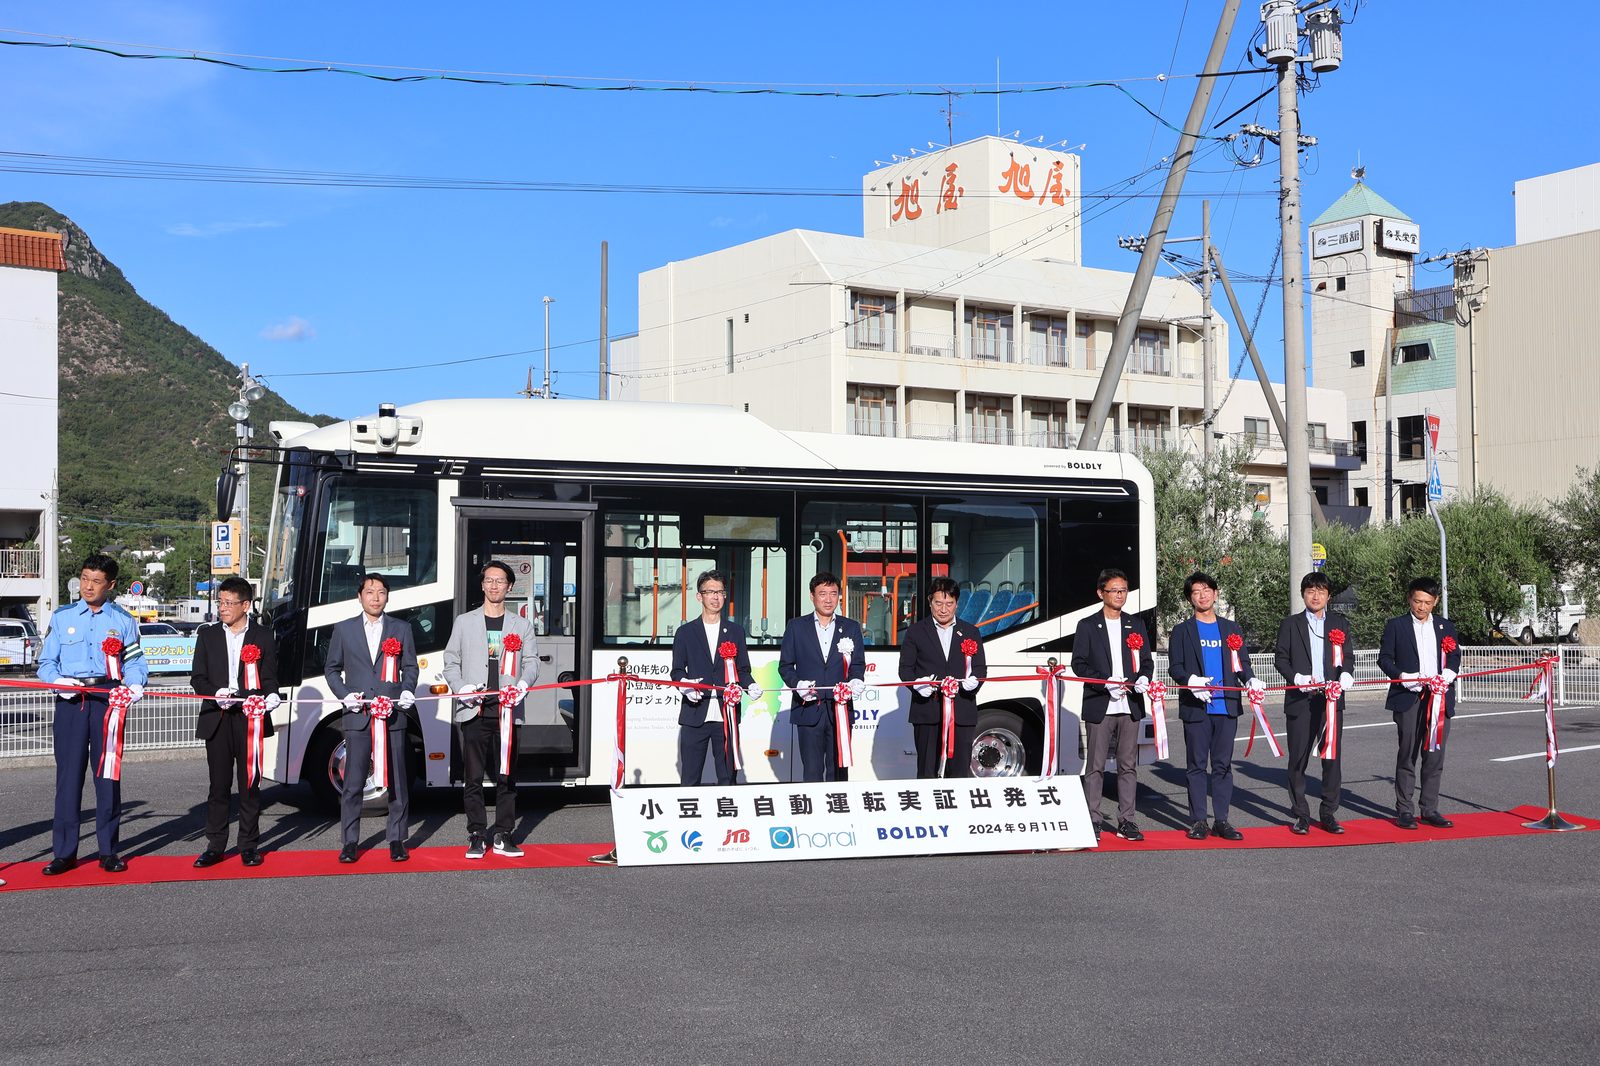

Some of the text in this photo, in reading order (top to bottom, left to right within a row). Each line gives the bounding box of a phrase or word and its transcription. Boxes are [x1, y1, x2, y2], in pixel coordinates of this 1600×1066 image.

[998, 158, 1071, 206] 旭屋
[892, 162, 964, 222] 旭屋
[1067, 462, 1102, 470] BOLDLY
[217, 526, 229, 541] P
[144, 646, 185, 656] エンジェル
[626, 664, 669, 675] 20年先の
[866, 663, 876, 672] TB
[626, 695, 680, 705] プロジェクト
[640, 785, 1061, 820] 小豆島自動運転実証出発式
[877, 825, 949, 840] BOLDLY
[968, 821, 1069, 835] 2024年9月11日
[795, 824, 857, 848] horai
